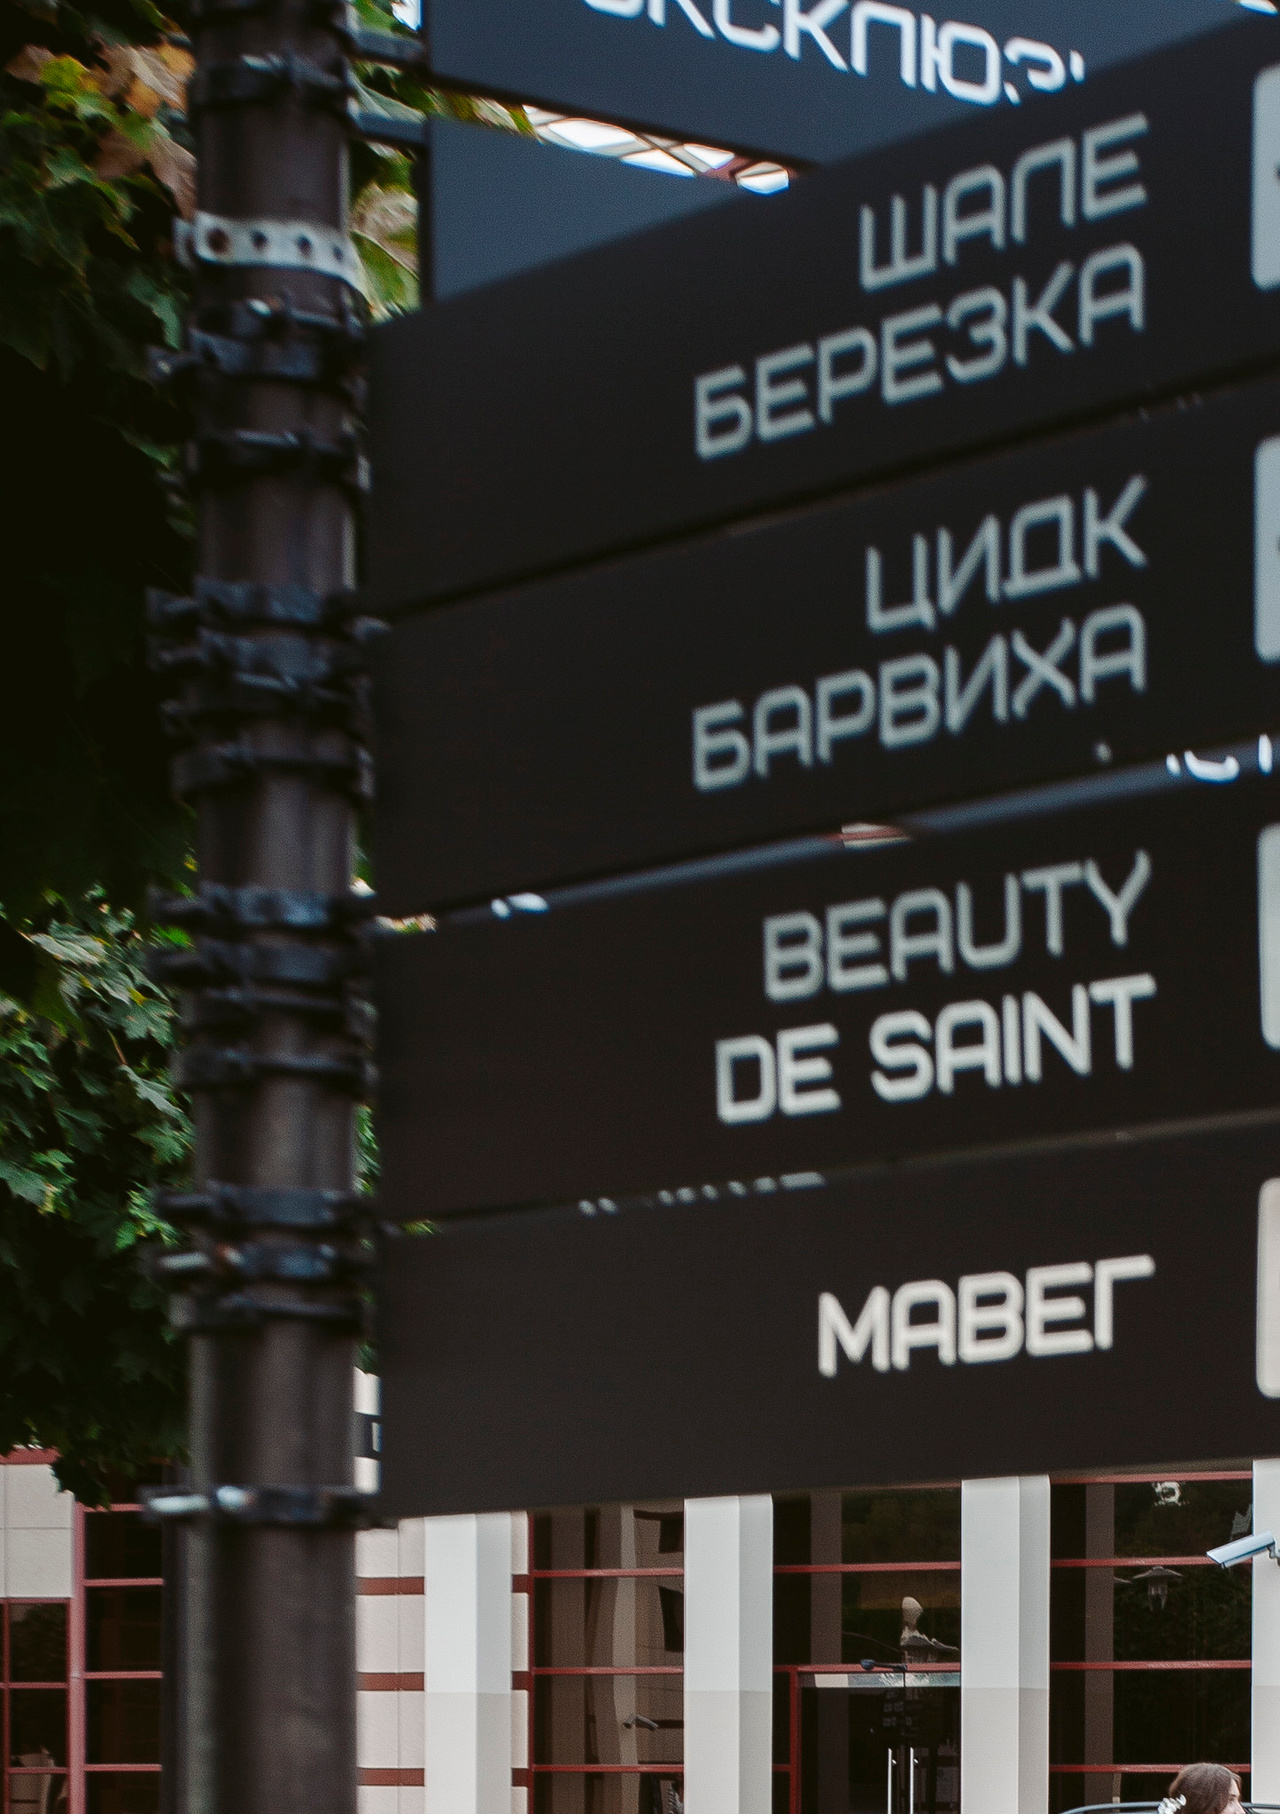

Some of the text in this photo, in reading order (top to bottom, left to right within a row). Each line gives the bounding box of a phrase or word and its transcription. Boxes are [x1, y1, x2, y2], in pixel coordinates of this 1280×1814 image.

[858, 111, 1149, 292] ШАЛЕ
[694, 243, 1146, 460] БЕРЕЗКА
[865, 475, 1148, 632] ЦИДК
[692, 603, 1147, 792] БАРВИХА
[762, 849, 1152, 1003] BEAUTY
[714, 971, 1158, 1125] DE SAINT
